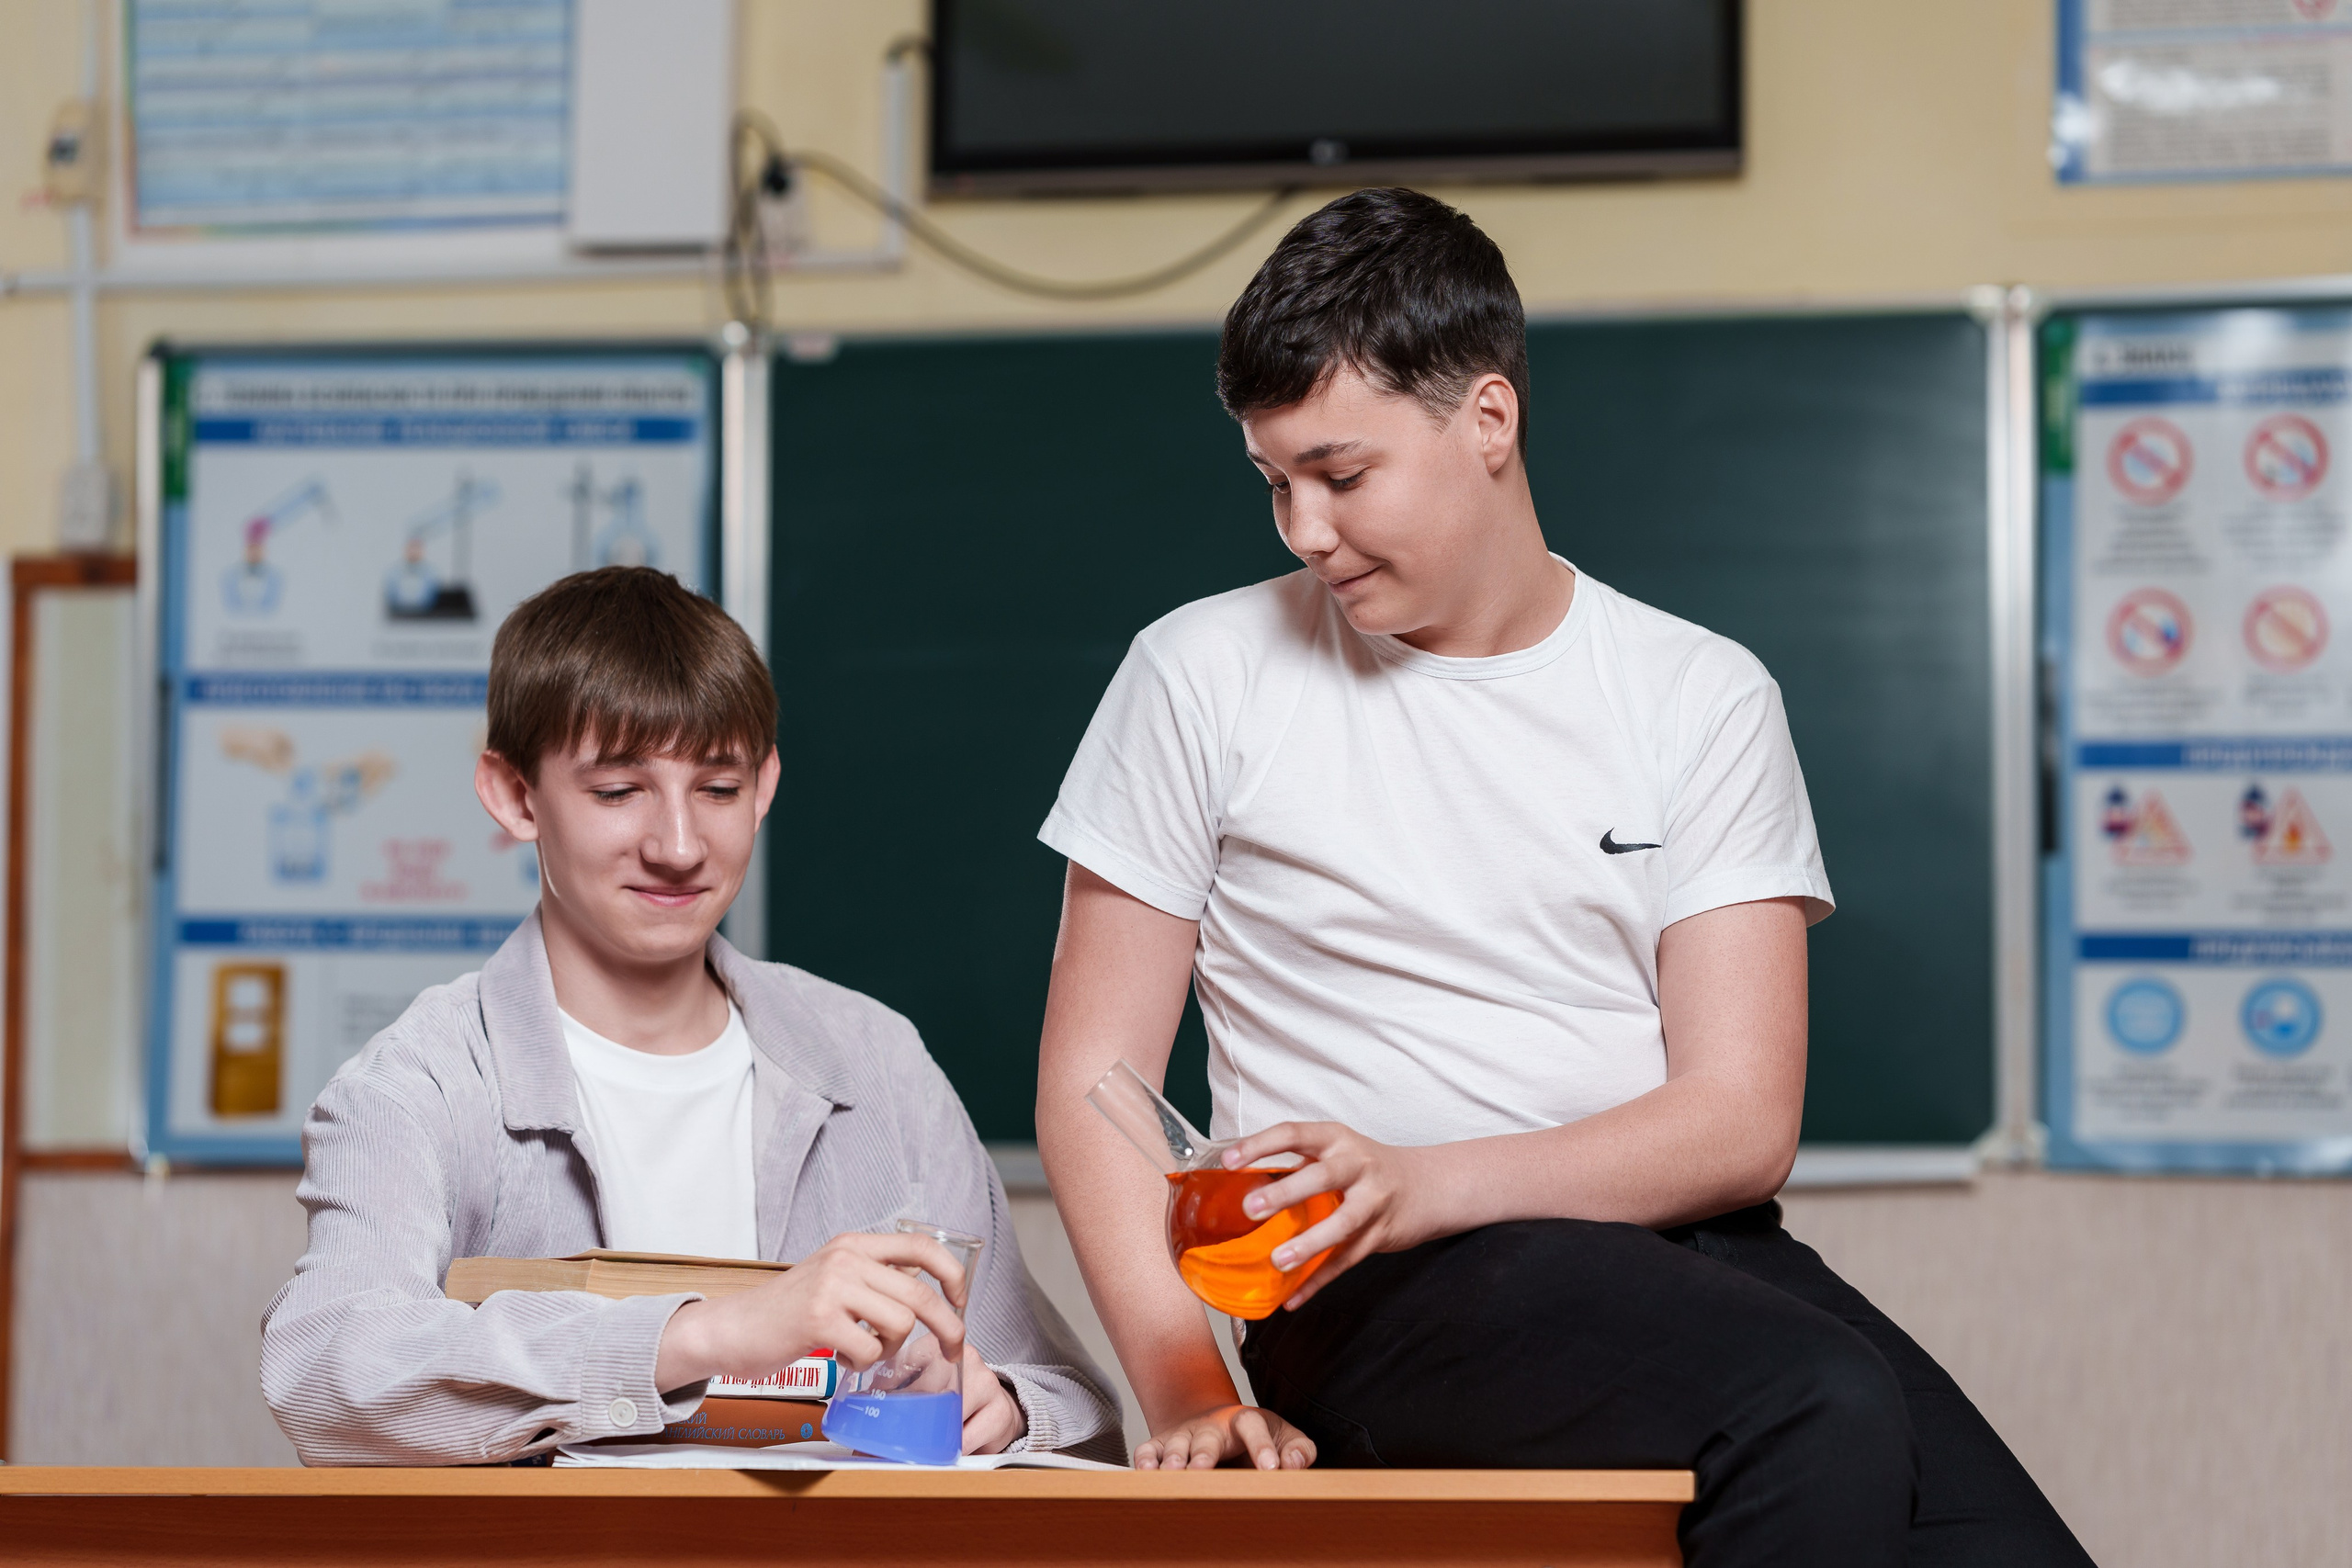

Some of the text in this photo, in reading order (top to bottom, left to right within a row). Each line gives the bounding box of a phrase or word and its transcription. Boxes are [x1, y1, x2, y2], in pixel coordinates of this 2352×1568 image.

[751, 1366, 821, 1390] АНГЛИЙСК
[871, 1388, 887, 1401] 150
[865, 1405, 880, 1418] 100
[738, 1427, 786, 1440] СЛОВАРЬ
